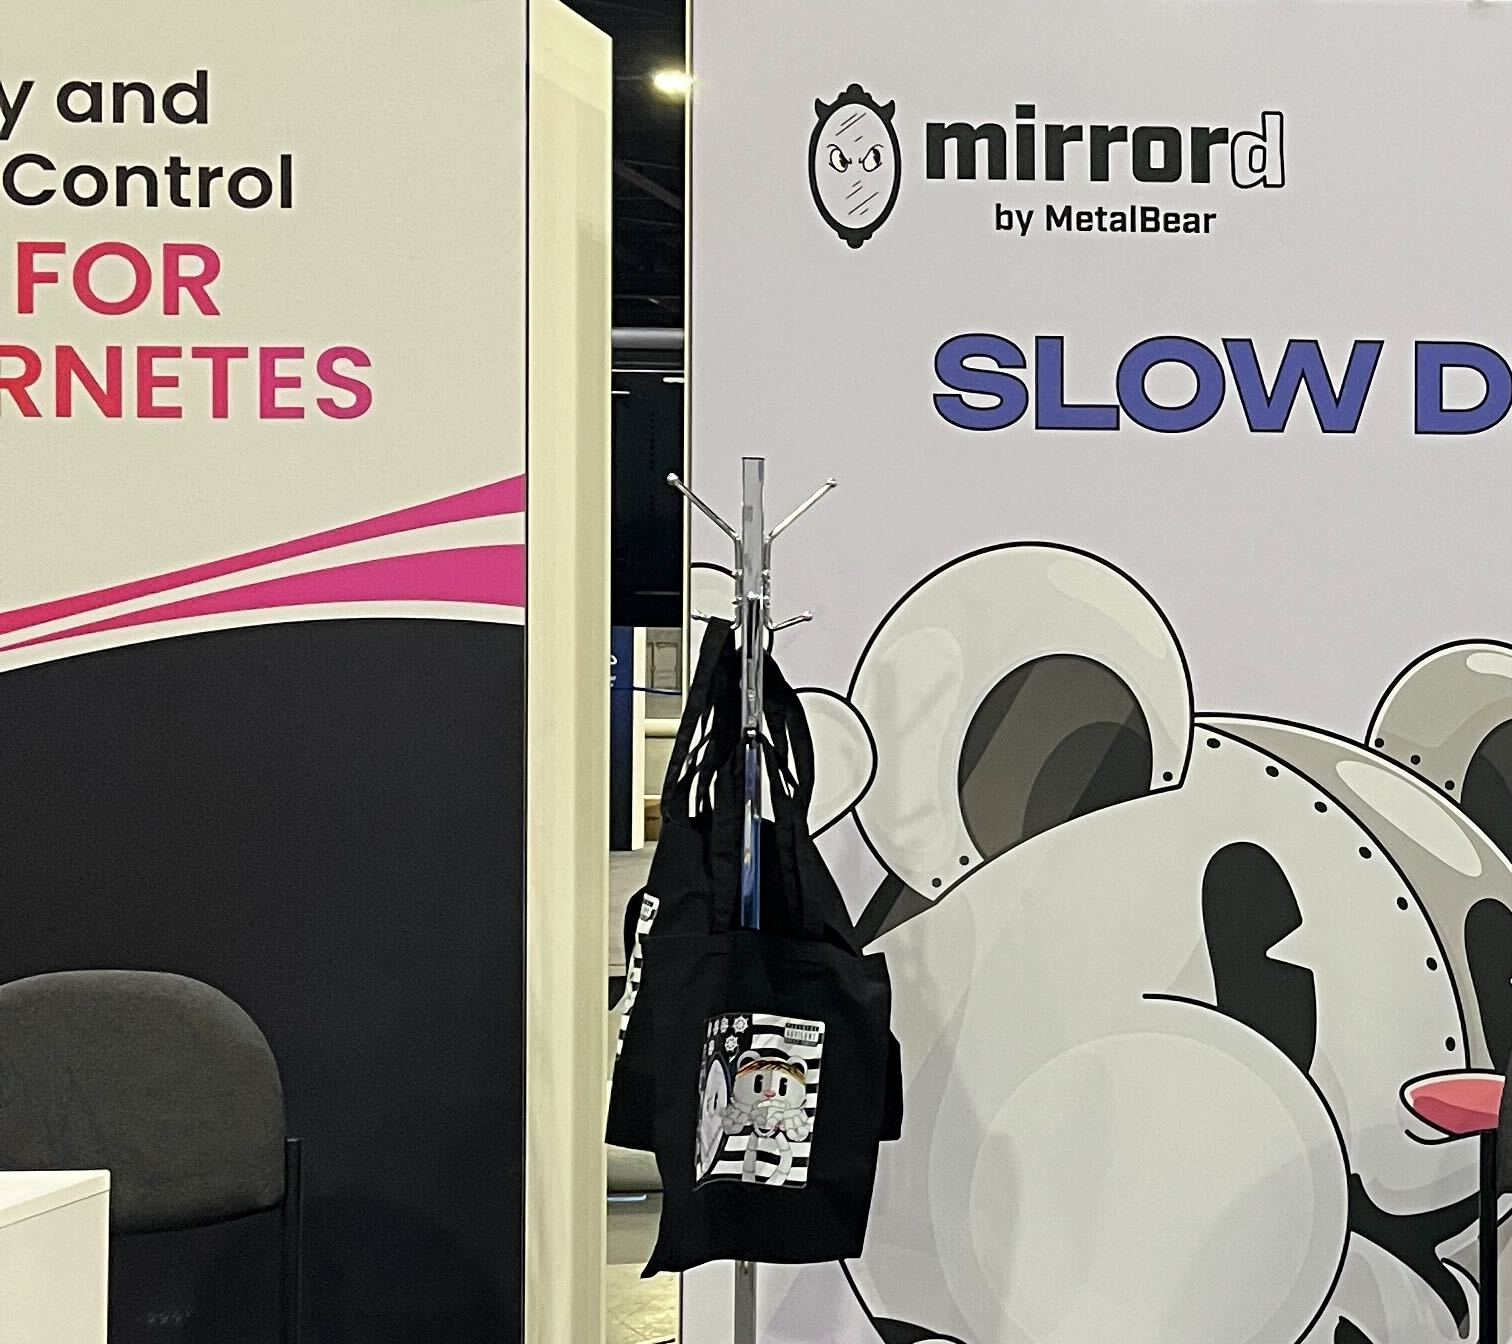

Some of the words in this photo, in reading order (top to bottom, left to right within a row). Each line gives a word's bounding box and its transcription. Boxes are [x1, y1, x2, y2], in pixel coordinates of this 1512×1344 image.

[57, 70, 207, 124] and
[927, 104, 1285, 189] mirrord
[3, 154, 292, 208] Control
[996, 203, 1033, 236] by
[1047, 205, 1216, 233] MetalBear
[18, 242, 220, 315] FOR
[933, 333, 1384, 433] SLOW
